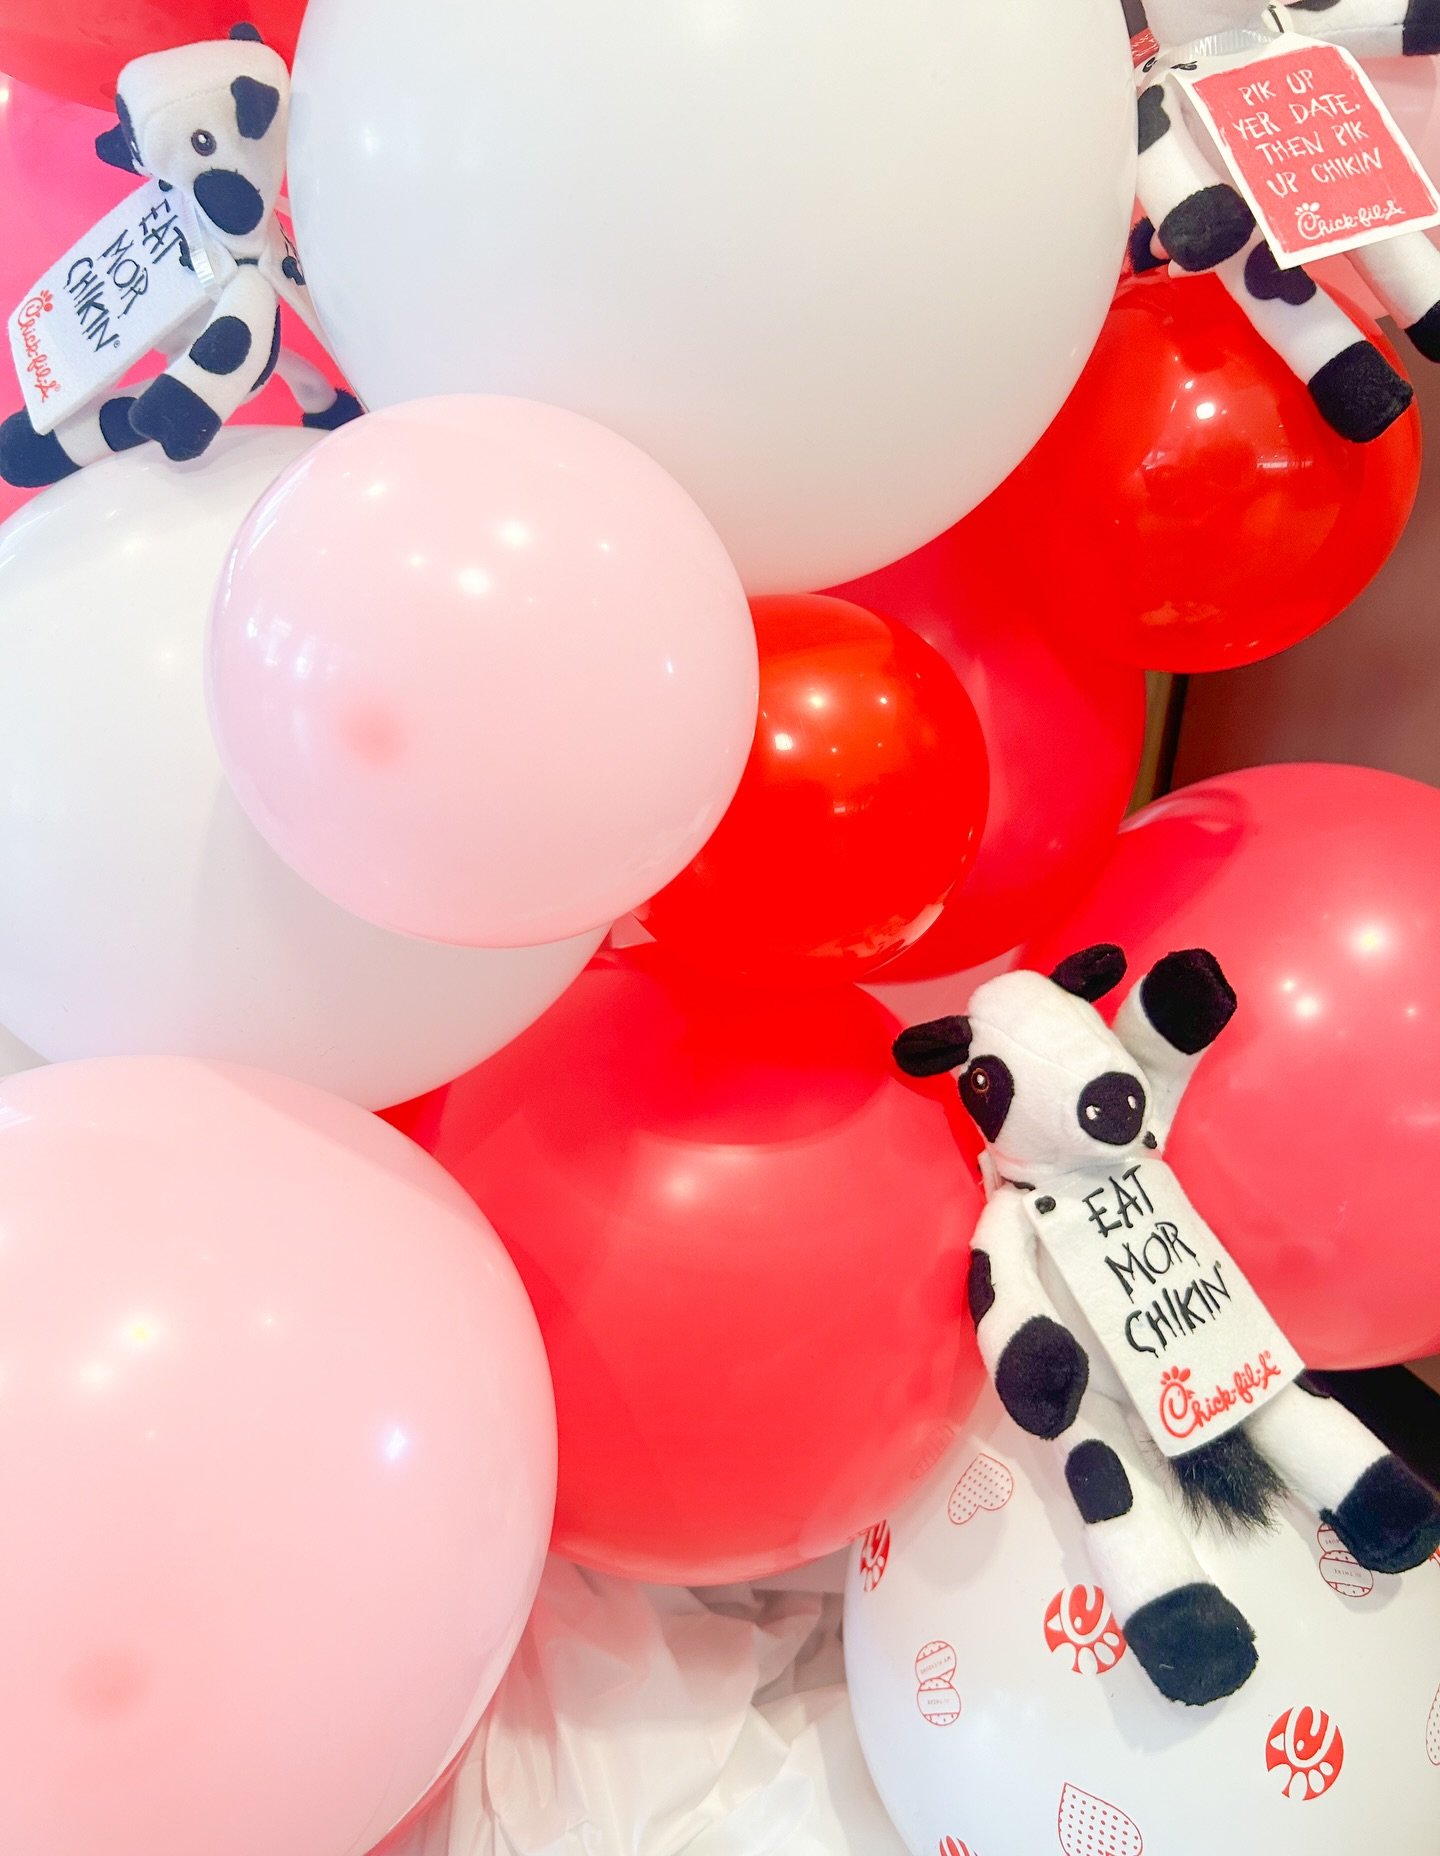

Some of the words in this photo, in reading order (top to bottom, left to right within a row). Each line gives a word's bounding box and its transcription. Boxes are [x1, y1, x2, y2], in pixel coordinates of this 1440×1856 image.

[1238, 79, 1276, 106] PIK
[1286, 69, 1314, 94] UP
[1232, 111, 1281, 141] YER
[1289, 93, 1361, 124] DATE.
[1255, 131, 1325, 166] THEN
[1331, 121, 1369, 147] PIK
[1266, 171, 1300, 199] UP
[1311, 147, 1383, 184] CHIKIN
[139, 198, 182, 264] EAT
[1295, 200, 1406, 240] Chick-fil-A
[97, 229, 149, 319] MOR
[1081, 1164, 1154, 1238] EAT
[1104, 1221, 1200, 1304] MOR
